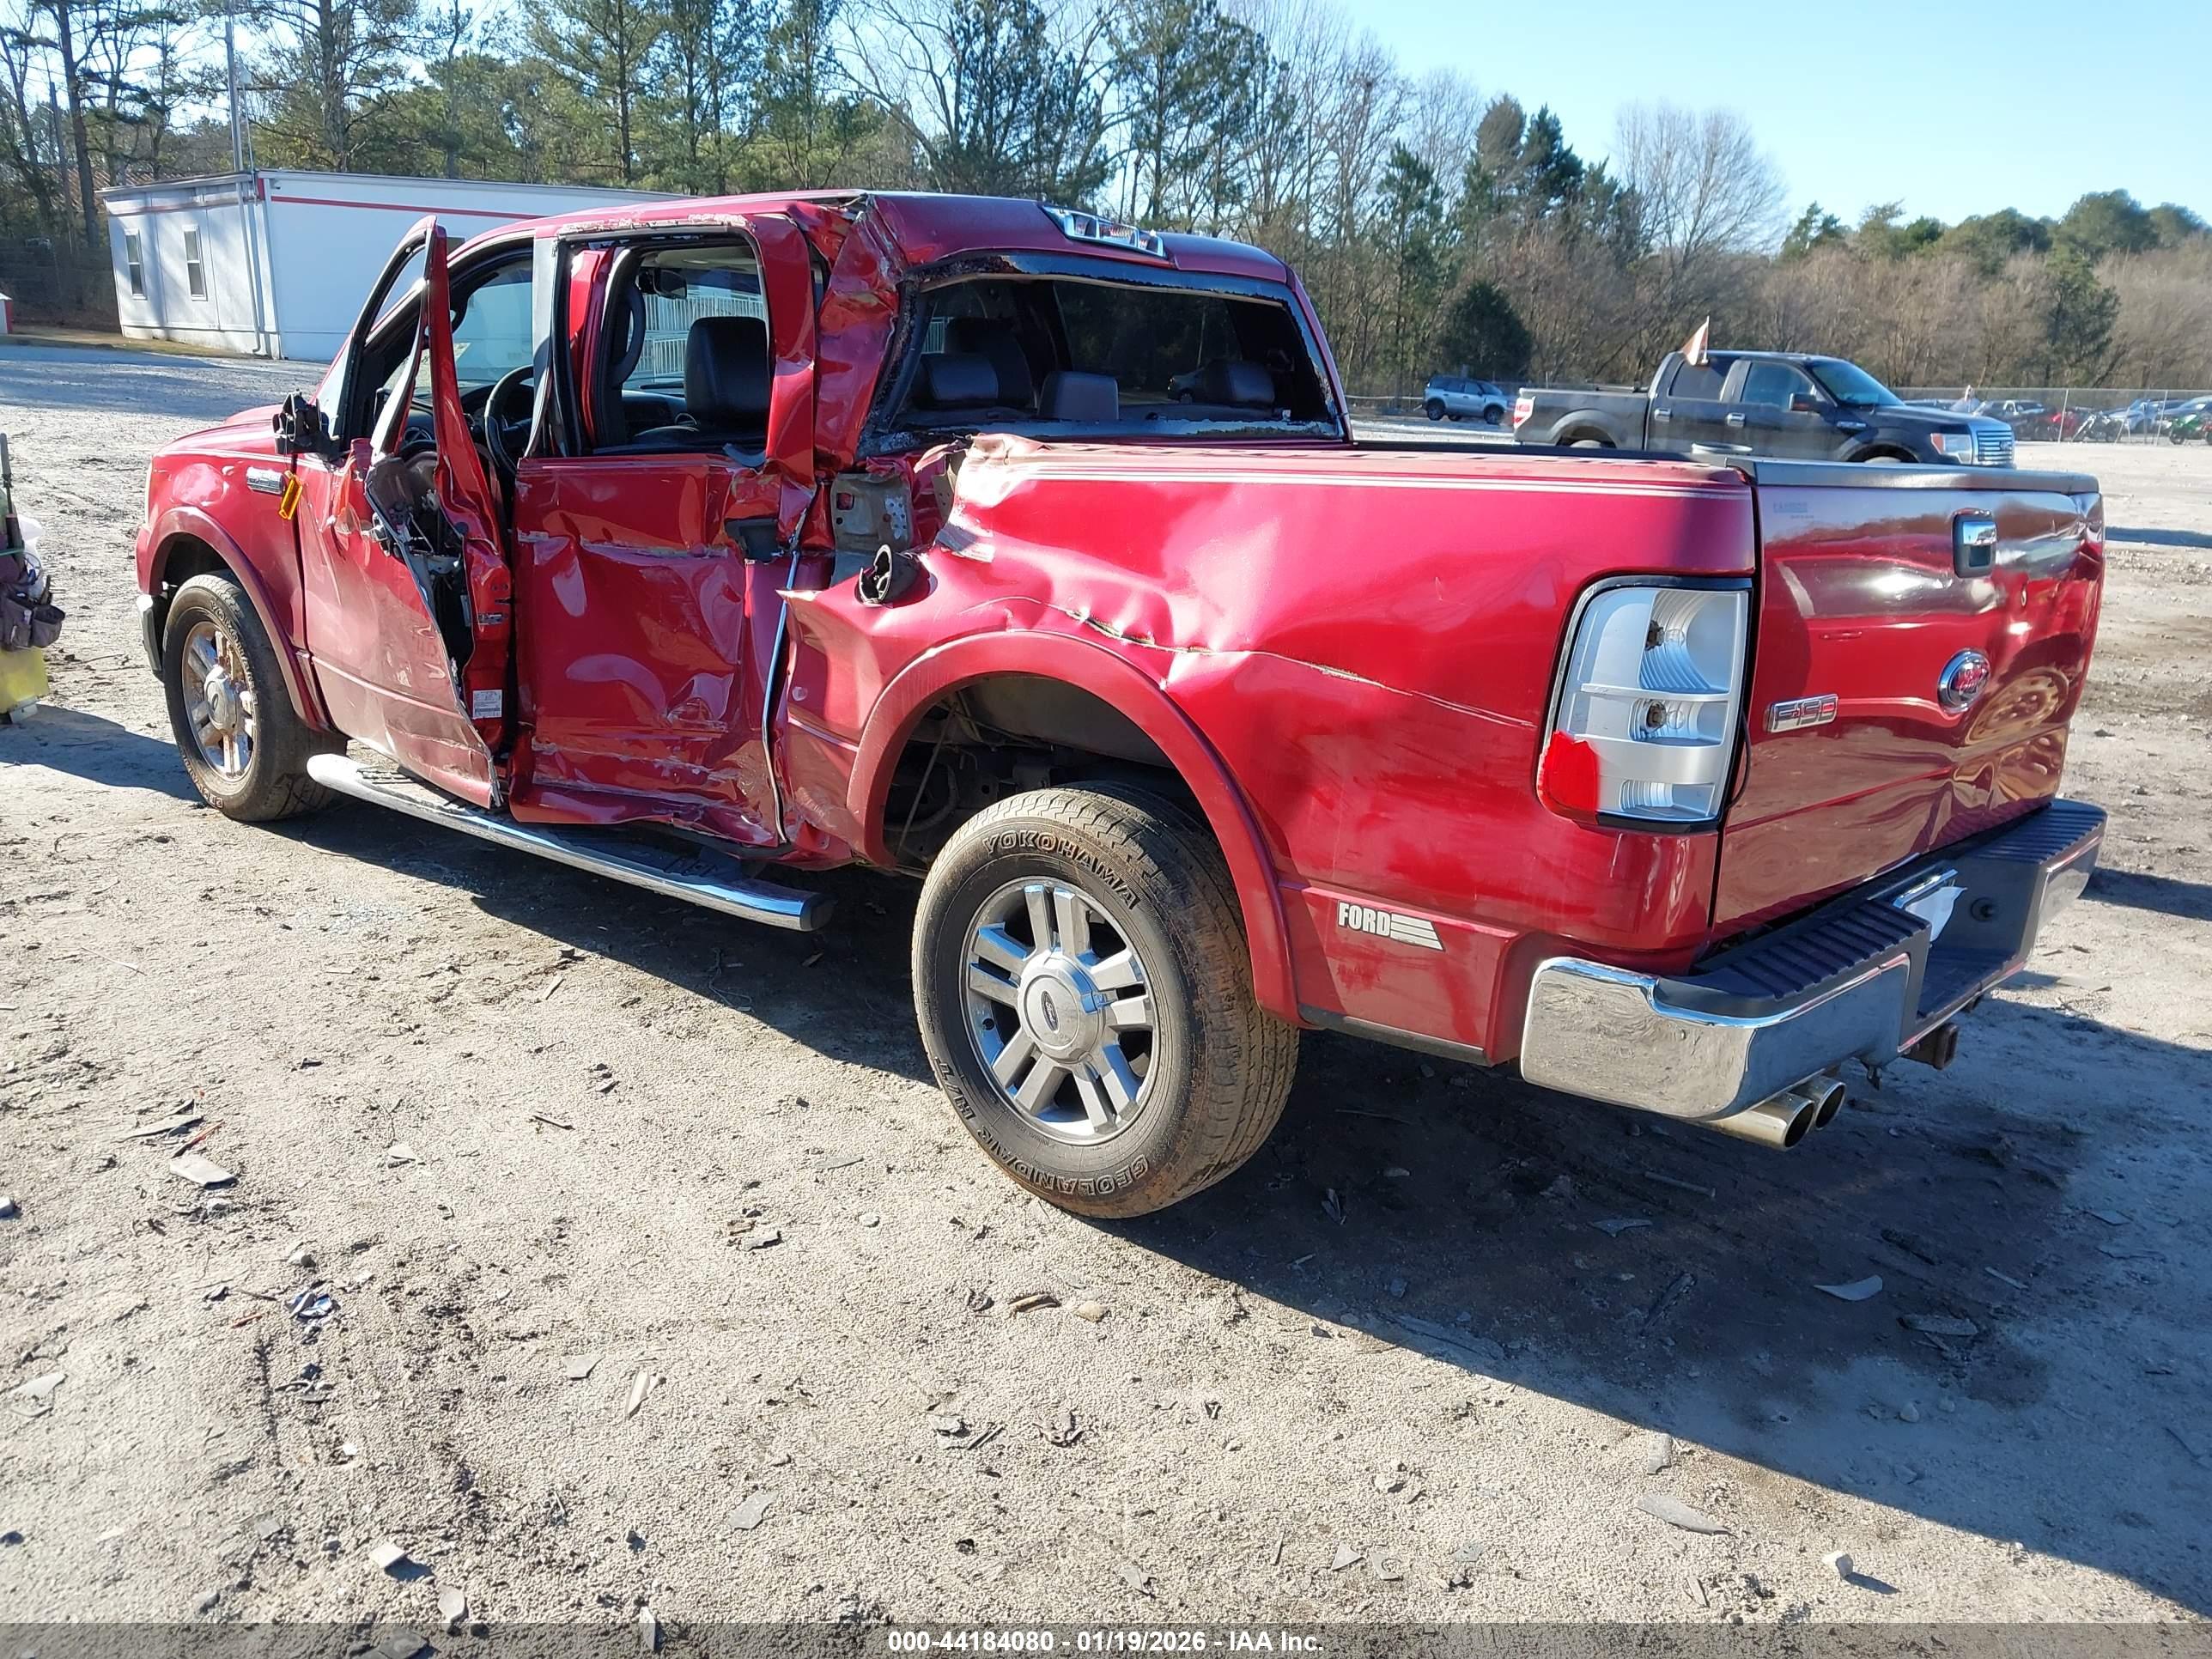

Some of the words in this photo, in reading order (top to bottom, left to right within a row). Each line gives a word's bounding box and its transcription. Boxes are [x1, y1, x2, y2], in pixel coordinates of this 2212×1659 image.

[982, 830, 1140, 910] YOKOHAMA
[1338, 901, 1390, 934] FORD
[976, 1125, 1149, 1195] GEOLANDAR
